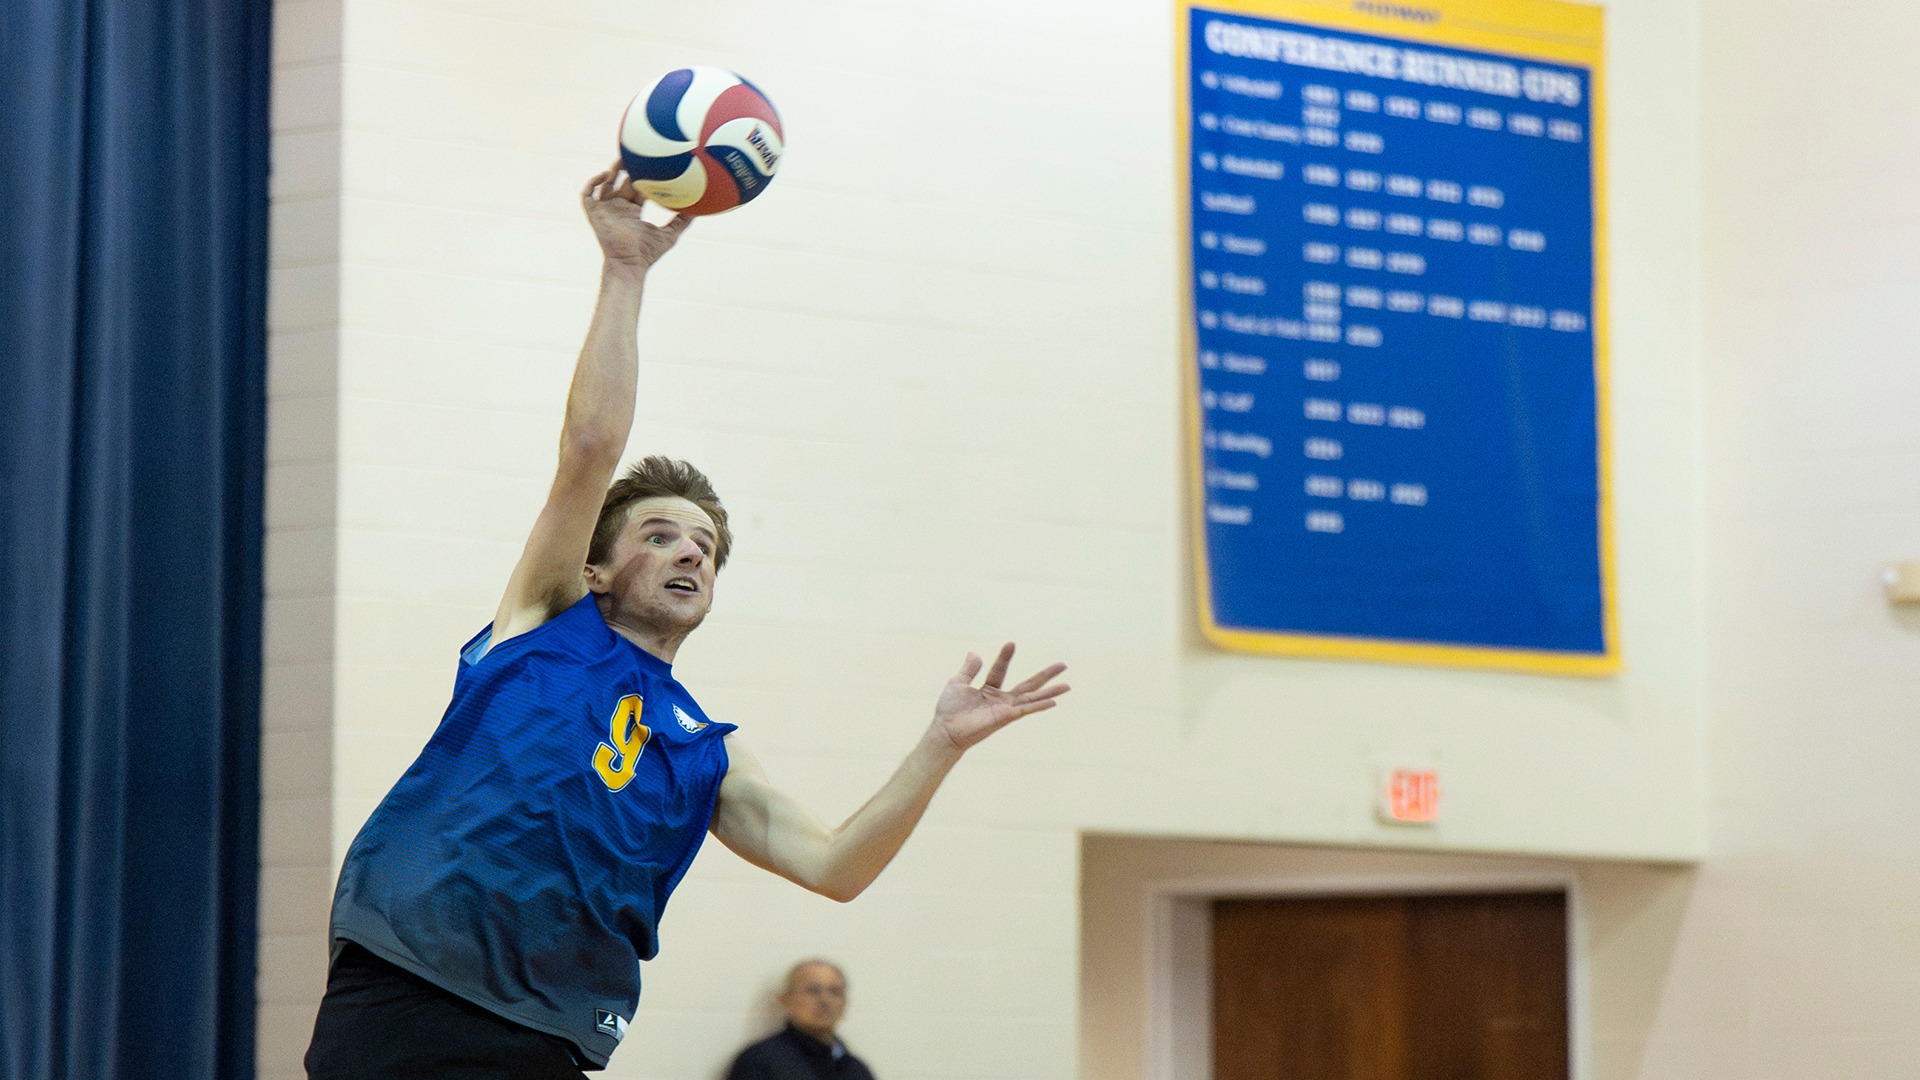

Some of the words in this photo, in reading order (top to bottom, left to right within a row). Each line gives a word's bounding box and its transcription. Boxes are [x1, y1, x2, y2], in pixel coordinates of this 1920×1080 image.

[1204, 19, 1399, 79] CONFERENCE
[1401, 48, 1522, 98] RUNNER
[591, 693, 652, 793] 9
